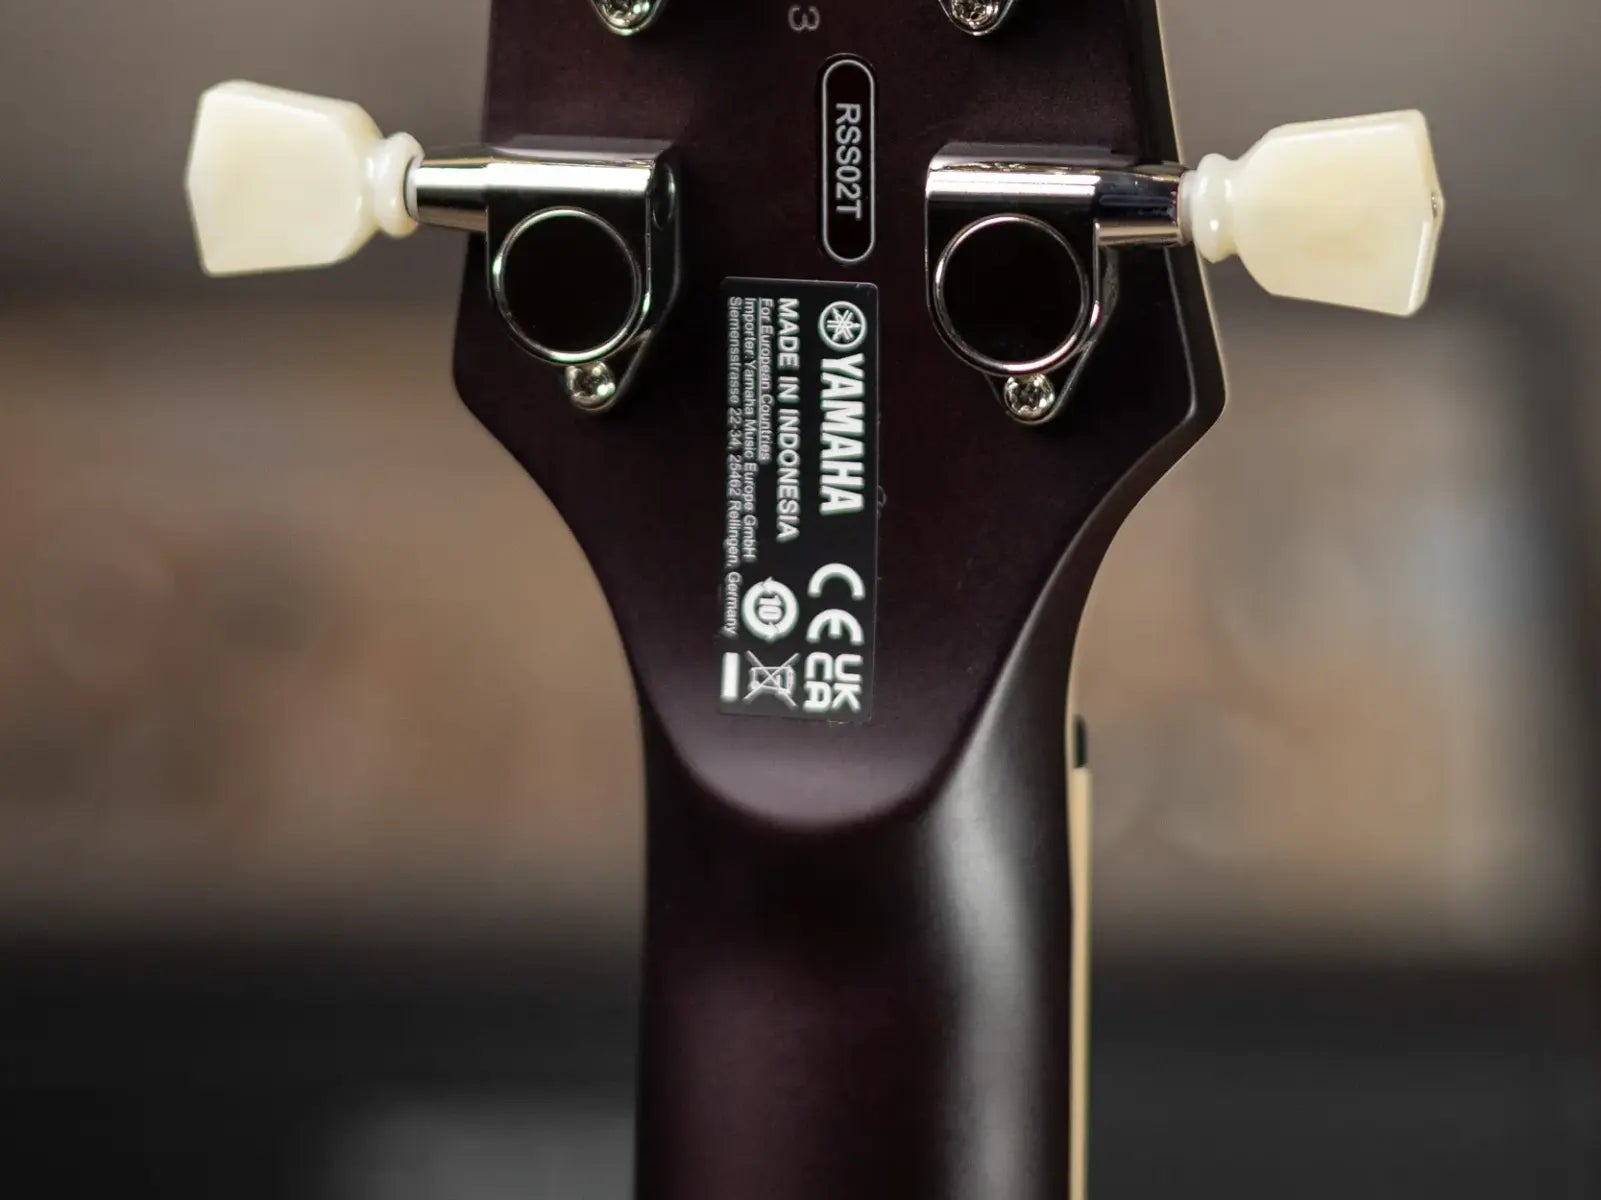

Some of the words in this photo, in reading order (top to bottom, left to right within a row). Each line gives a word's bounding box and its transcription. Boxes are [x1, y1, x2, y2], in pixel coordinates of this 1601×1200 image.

[835, 103, 862, 221] RSS02T
[758, 297, 774, 321] For
[777, 298, 800, 368] MADE
[728, 296, 742, 403] Siemensstrasse
[758, 323, 773, 390] European
[743, 360, 757, 415] Yamaha
[777, 376, 799, 403] IN
[743, 418, 757, 459] Music
[758, 393, 774, 462] Countries
[820, 353, 865, 515] YAMAHA
[727, 453, 742, 497] 25462
[742, 461, 758, 512] Europe
[777, 409, 800, 542] INDONESIA
[742, 514, 758, 561] GmbH
[722, 571, 742, 635] Germany
[758, 594, 782, 623] 10
[806, 563, 866, 645] CE
